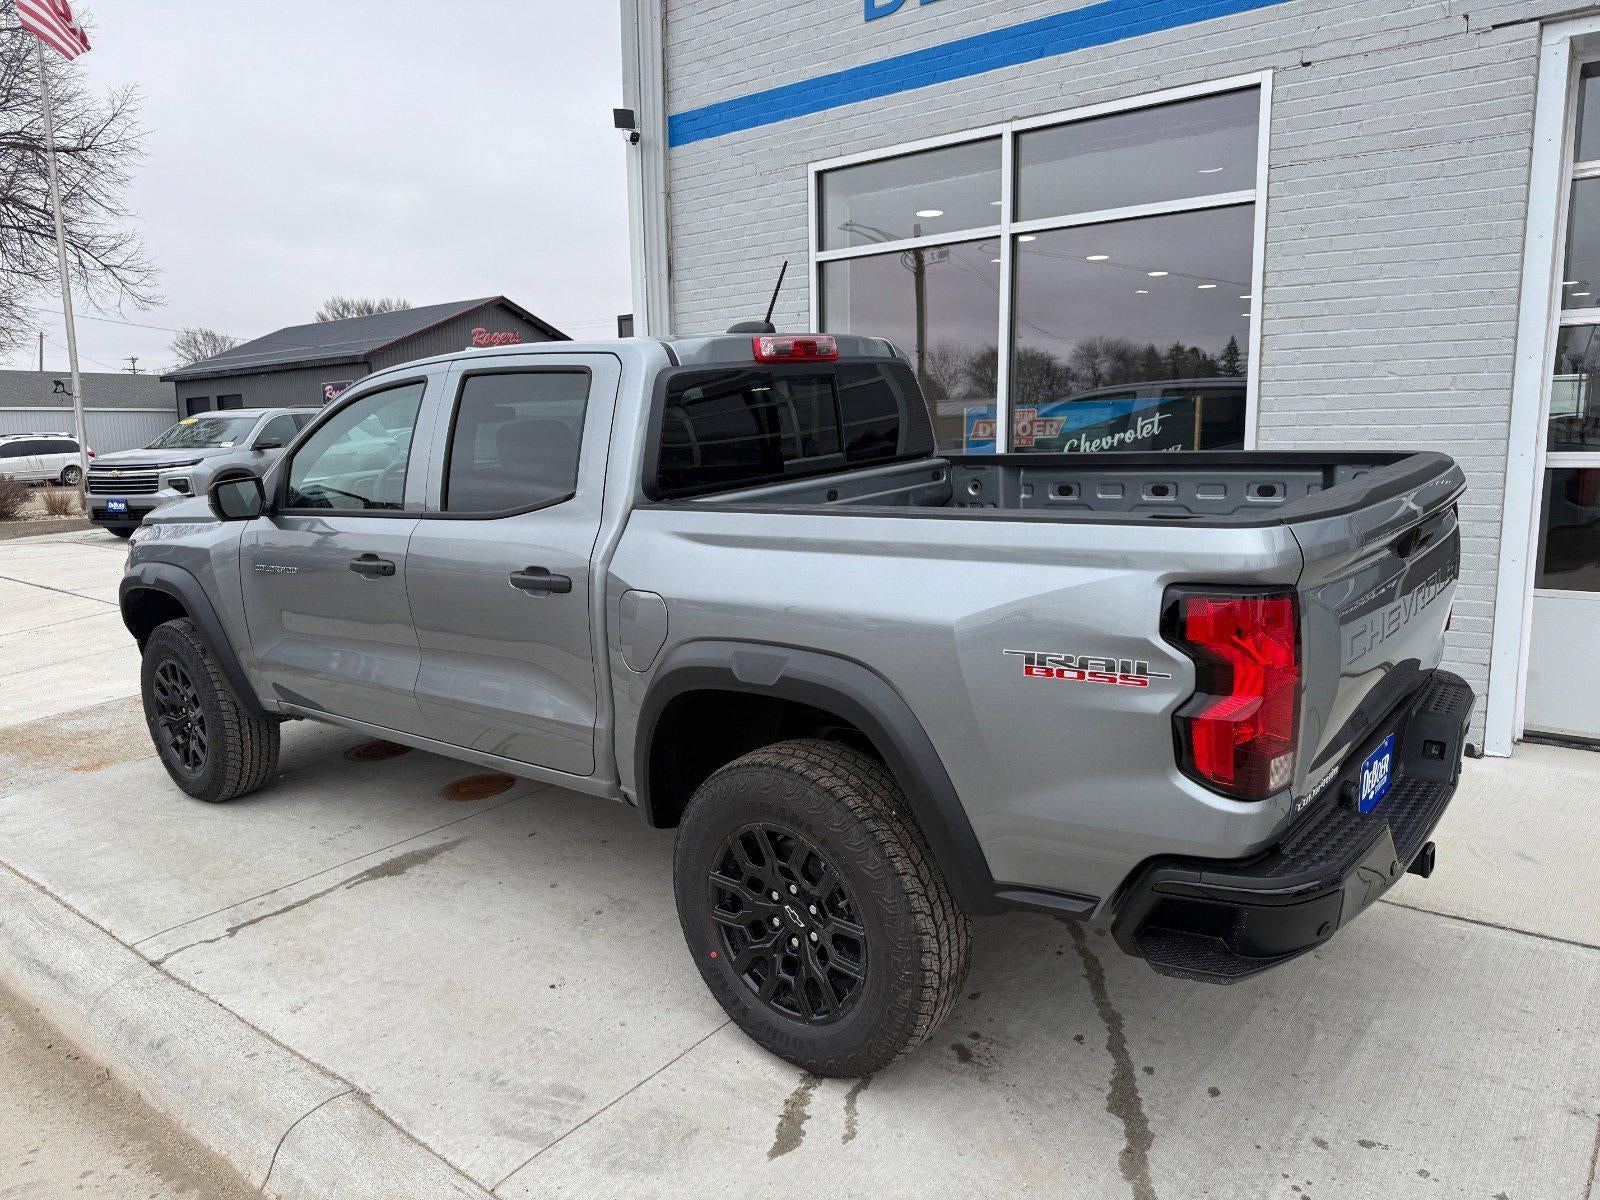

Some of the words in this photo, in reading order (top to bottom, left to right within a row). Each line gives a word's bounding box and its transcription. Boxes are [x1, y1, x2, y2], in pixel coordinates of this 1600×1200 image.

[978, 419, 1058, 437] DOER
[1063, 412, 1172, 452] Chevrolet
[1346, 554, 1457, 666] CHEVROLE
[1003, 649, 1171, 679] TRAIL
[1024, 665, 1149, 688] BOSS
